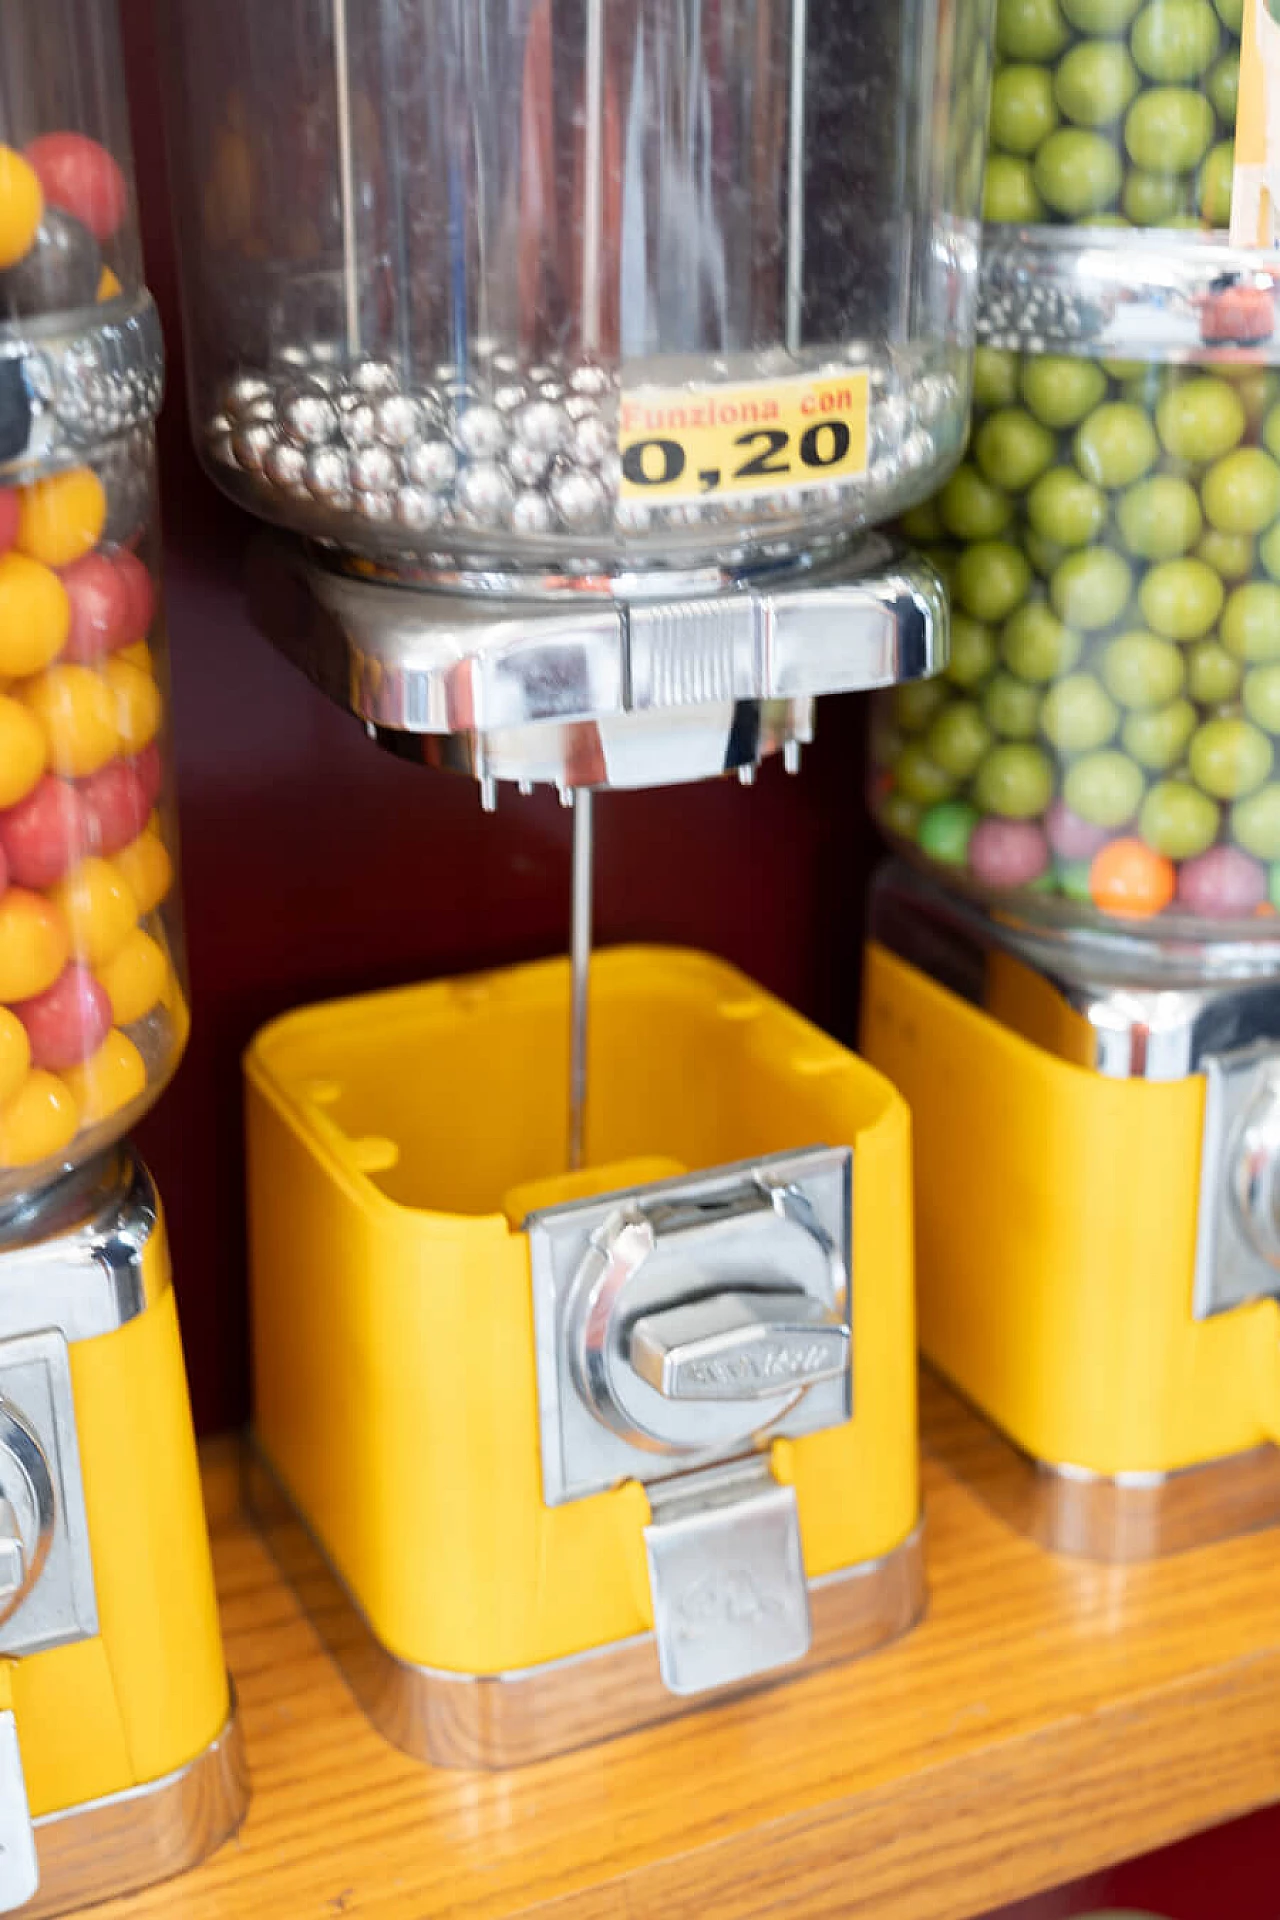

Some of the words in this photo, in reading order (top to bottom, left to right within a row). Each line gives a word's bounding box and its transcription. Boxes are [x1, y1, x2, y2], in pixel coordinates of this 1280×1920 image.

[621, 397, 779, 431] Funziona
[801, 388, 853, 417] con
[621, 420, 851, 492] 0,20
